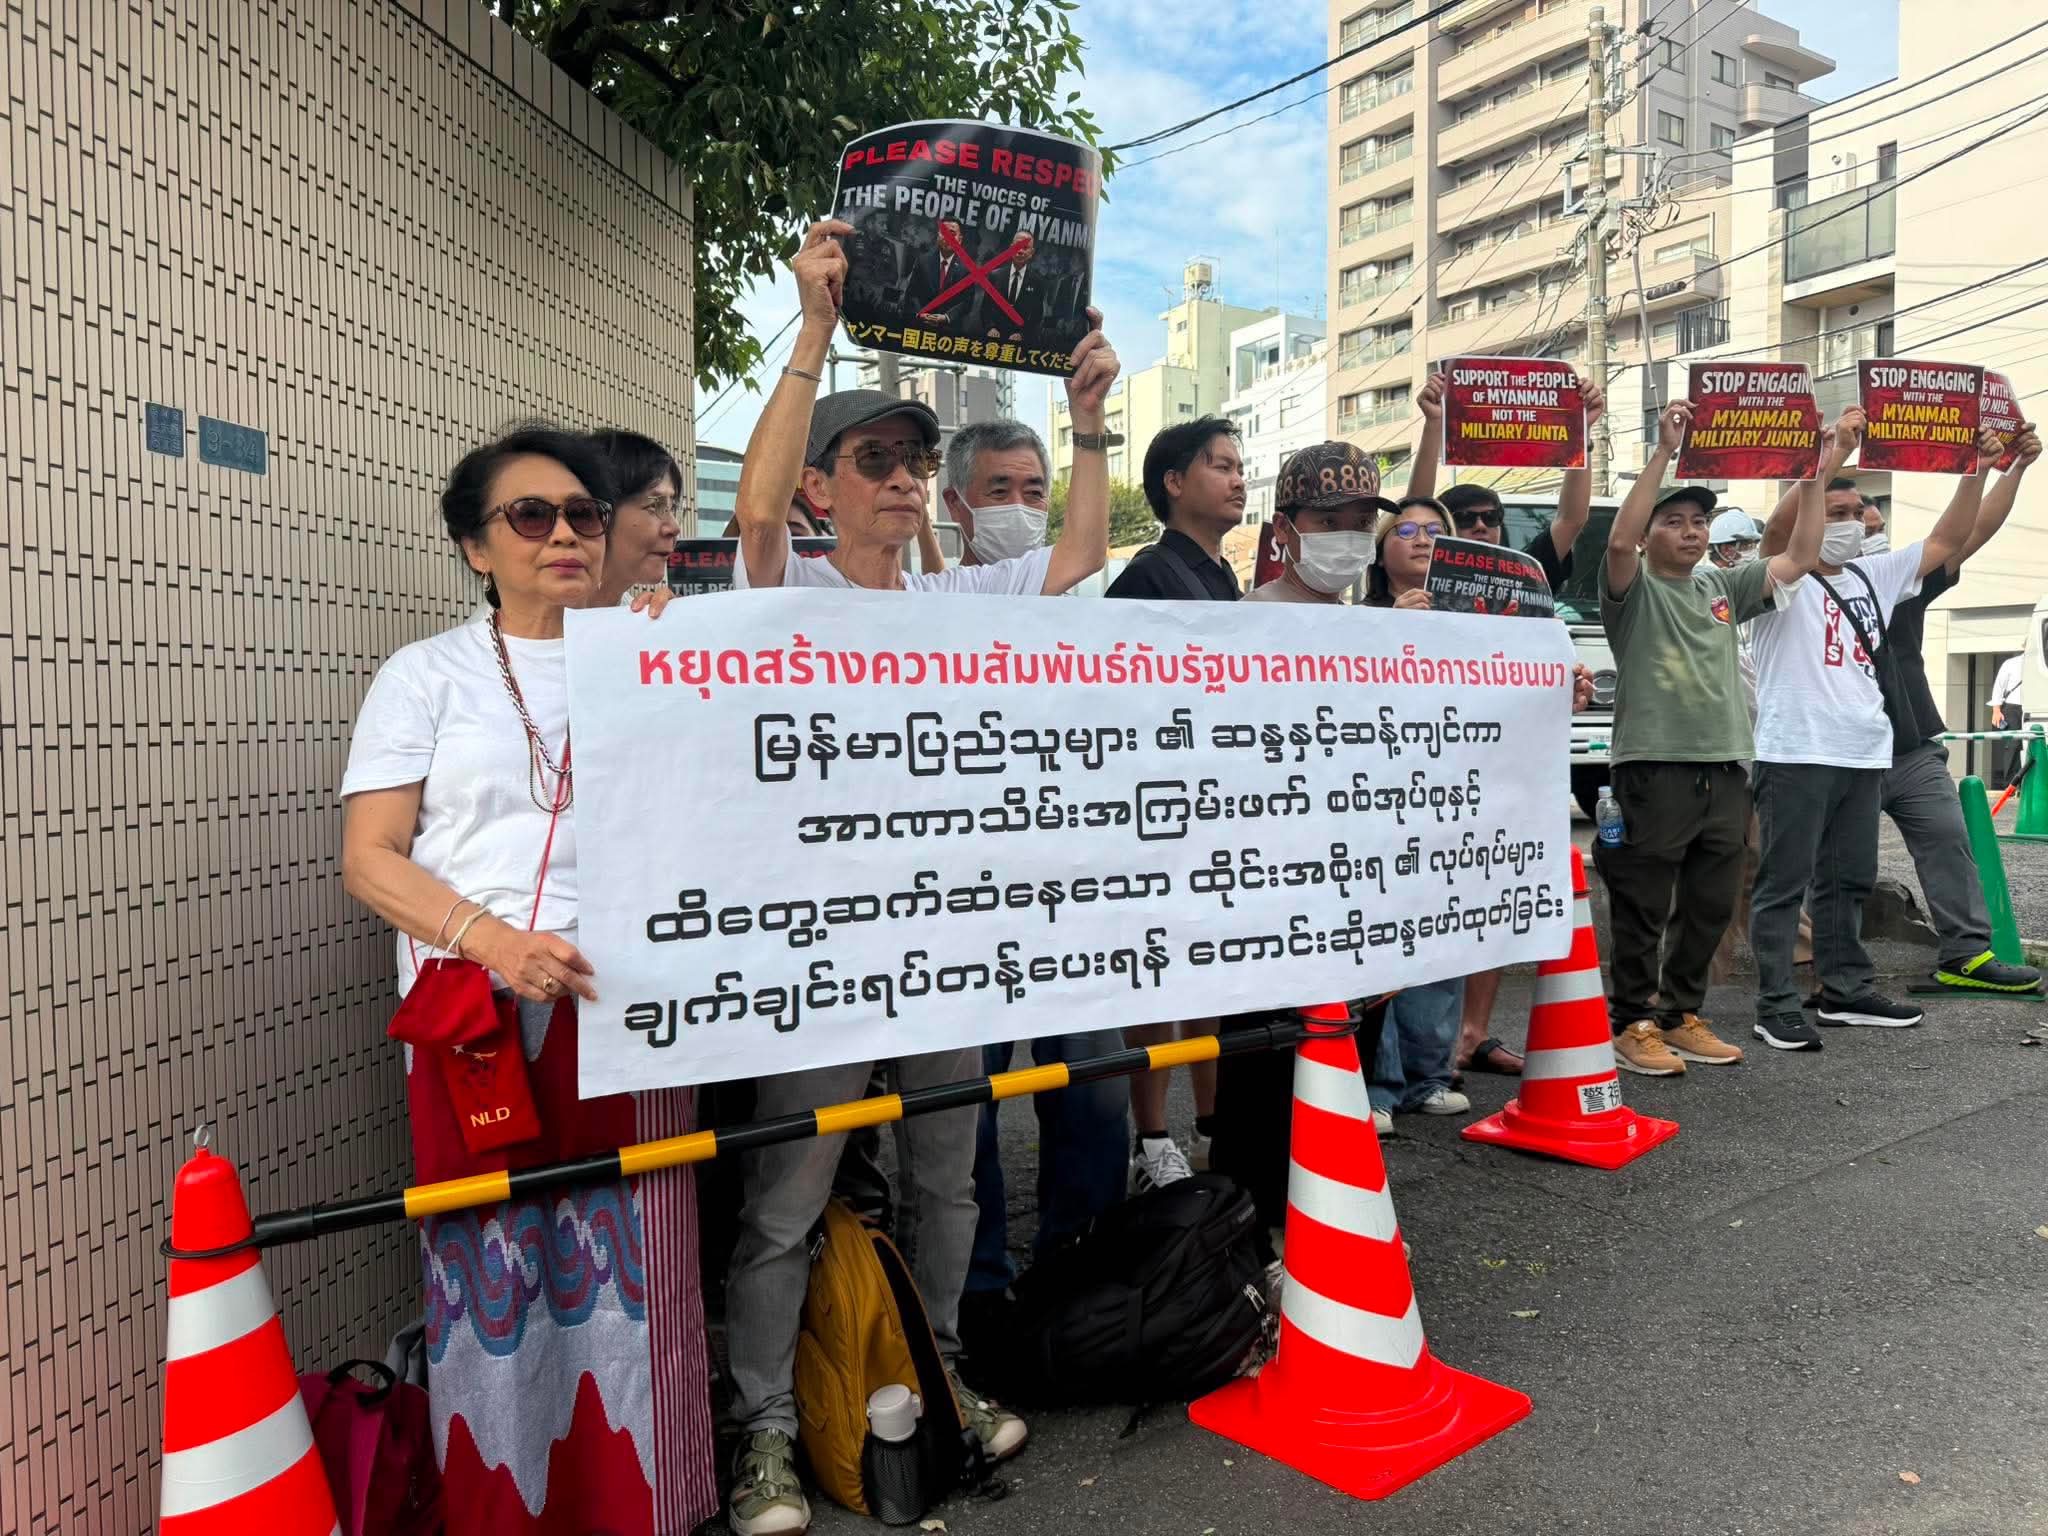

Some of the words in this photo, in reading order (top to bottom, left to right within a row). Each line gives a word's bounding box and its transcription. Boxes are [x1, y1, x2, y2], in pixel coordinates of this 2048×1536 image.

[844, 139, 982, 171] PLEASE
[934, 174, 966, 195] THE
[972, 181, 1027, 207] VOICES
[1030, 195, 1051, 212] OF
[842, 183, 888, 209] THE
[895, 185, 982, 228] PEOPLE
[985, 203, 1009, 233] OF
[1018, 212, 1092, 250] MYANM
[1453, 369, 1510, 387] SUPPORT
[1511, 375, 1527, 387] THE
[1528, 371, 1577, 389] PEOPLE
[1701, 371, 1746, 394] STOP
[1869, 367, 1908, 388] STOP
[1910, 370, 1976, 394] ENGAGING
[1472, 391, 1486, 404] OF
[1487, 388, 1558, 407] MYANMAR
[1738, 396, 1765, 407] WITH
[1766, 396, 1785, 407] THE
[1903, 391, 1926, 403] WITH
[1927, 392, 1944, 404] THE
[1990, 399, 2009, 415] NUG
[1492, 409, 1513, 422] NOT
[1516, 410, 1537, 422] THE
[1711, 409, 1803, 429] MYANMAR
[1882, 403, 1962, 425] MYANMAR
[1461, 423, 1524, 440] MILITARY
[1526, 425, 1568, 441] JUNTA
[1690, 430, 1763, 449] MILITARY
[1762, 430, 1816, 449] JUNTA!
[1868, 421, 1929, 441] MILITARY
[1929, 425, 1976, 445] JUNTA!
[668, 551, 736, 569] PLEA
[1434, 548, 1495, 571] PLEASE
[1430, 577, 1452, 592] THE
[1455, 580, 1493, 599] PEOPLE
[1496, 587, 1509, 601] OF
[1473, 573, 1489, 583] THE
[1490, 576, 1515, 588] VOICES
[1515, 581, 1525, 589] OF
[639, 633, 1565, 700] หยุดสร้างความสัมพันธ์กับรัฐบาลทหารเผด็จการเมียนมา
[470, 1106, 511, 1128] NLD
